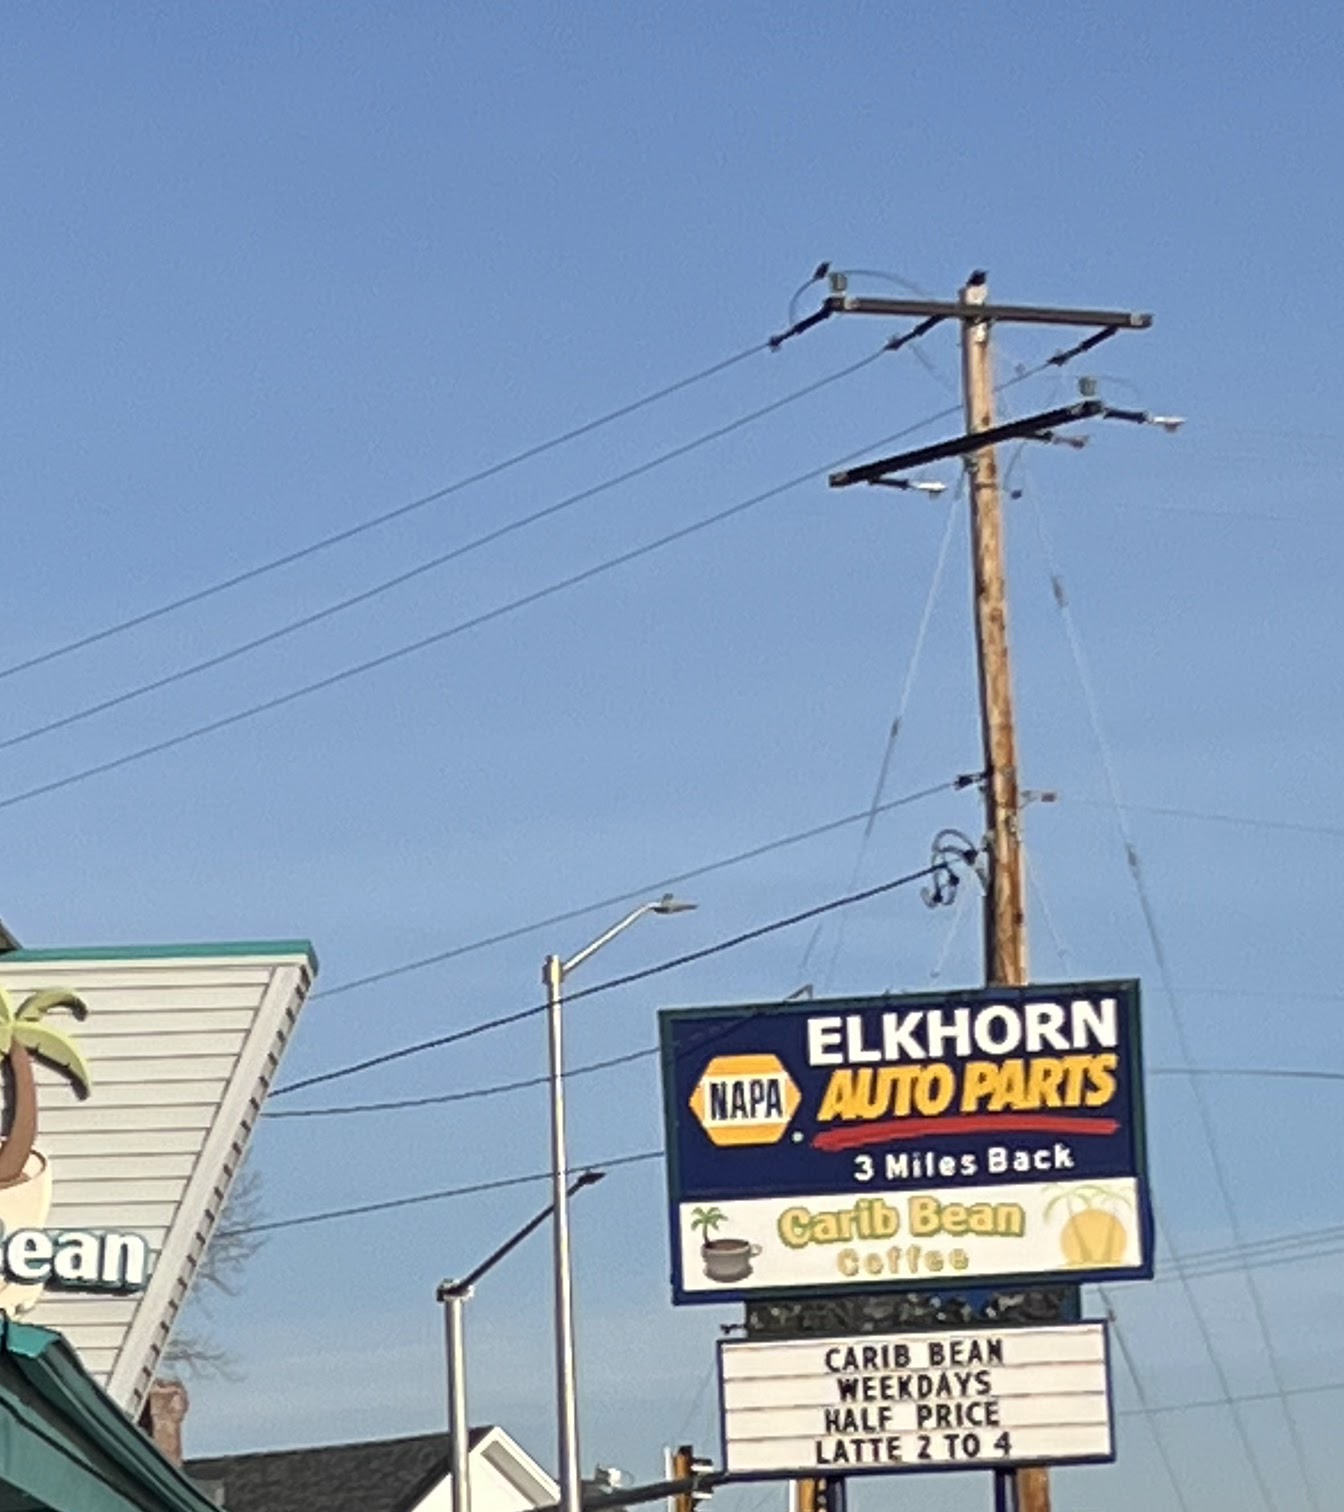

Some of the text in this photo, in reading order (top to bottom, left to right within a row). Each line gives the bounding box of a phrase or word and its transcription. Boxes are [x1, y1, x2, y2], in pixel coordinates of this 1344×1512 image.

[807, 998, 1118, 1066] ELKHORN
[709, 1078, 784, 1122] NAPA
[817, 1054, 1119, 1123] AUTO PARTS
[854, 1142, 1075, 1181] 3 Miles Back
[778, 1195, 1026, 1249] Carib Bean
[836, 1245, 970, 1276] Coffee
[824, 1338, 1005, 1373] CARIB BEAN
[836, 1369, 993, 1402] WEEKDAYS
[824, 1400, 1001, 1434] HALF PRICE
[815, 1430, 1012, 1465] LATTE 2 TO 4
